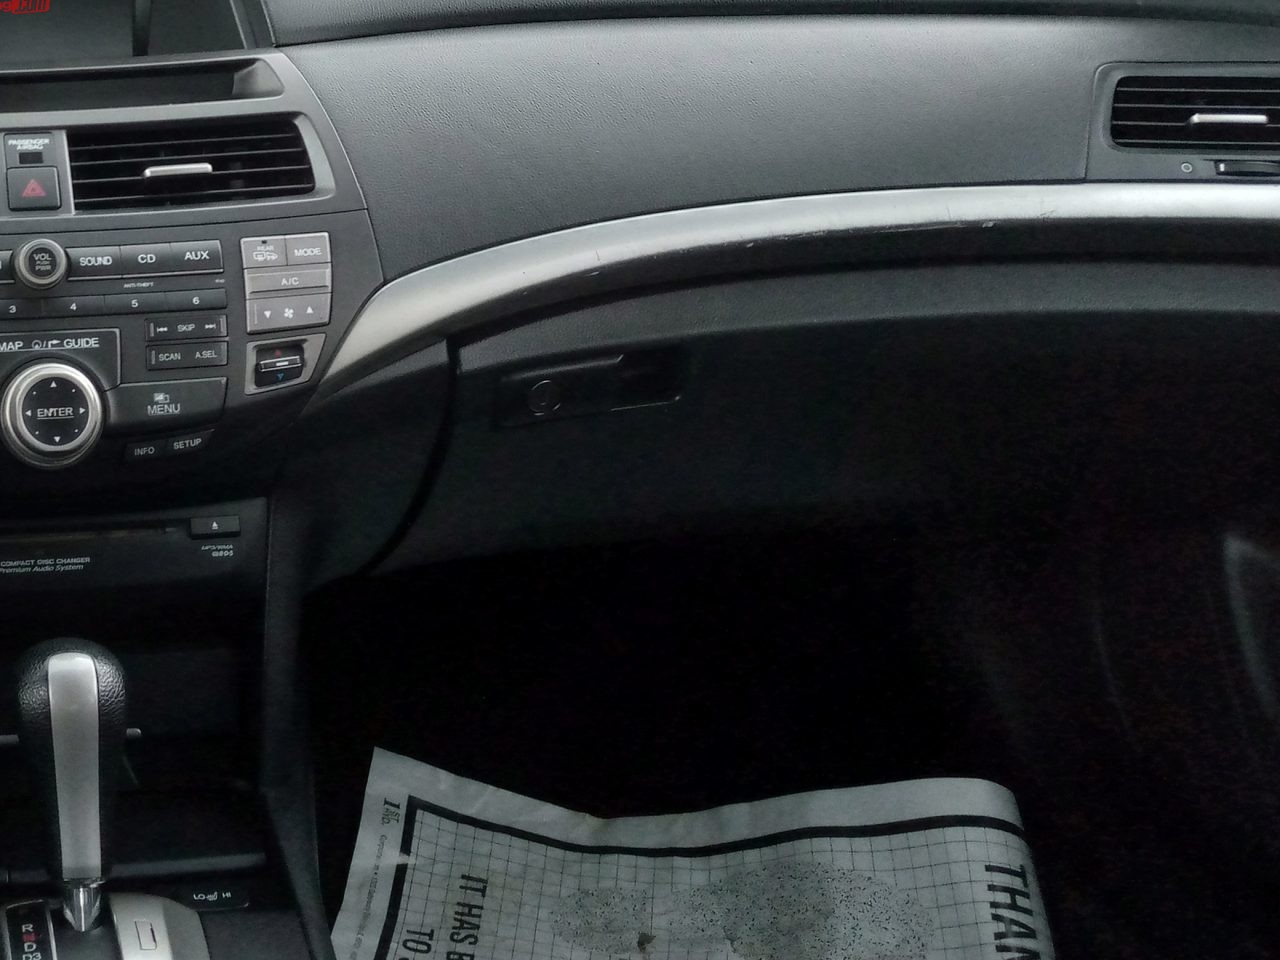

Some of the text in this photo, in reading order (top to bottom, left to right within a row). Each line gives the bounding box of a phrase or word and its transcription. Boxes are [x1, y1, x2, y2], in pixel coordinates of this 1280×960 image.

[33, 253, 52, 261] VOL
[184, 250, 210, 261] AUX
[294, 247, 322, 257] MODE
[80, 255, 112, 266] SOUND
[137, 253, 156, 264] CD
[281, 277, 299, 286] A/C
[131, 299, 139, 308] 5
[192, 296, 200, 305] 6
[9, 305, 16, 314] 3
[70, 303, 77, 311] 4
[177, 323, 195, 332] SKIP
[63, 338, 100, 349] GUIDE
[158, 352, 181, 361] SCAN
[37, 407, 74, 417] ENTER
[147, 403, 181, 415] MENU
[173, 438, 202, 449] SETUP
[134, 447, 155, 456] INFO
[55, 564, 84, 572] System
[459, 874, 488, 898] IT
[22, 924, 34, 932] R
[449, 902, 484, 946] HAS
[402, 928, 435, 955] TO
[24, 942, 36, 952] D
